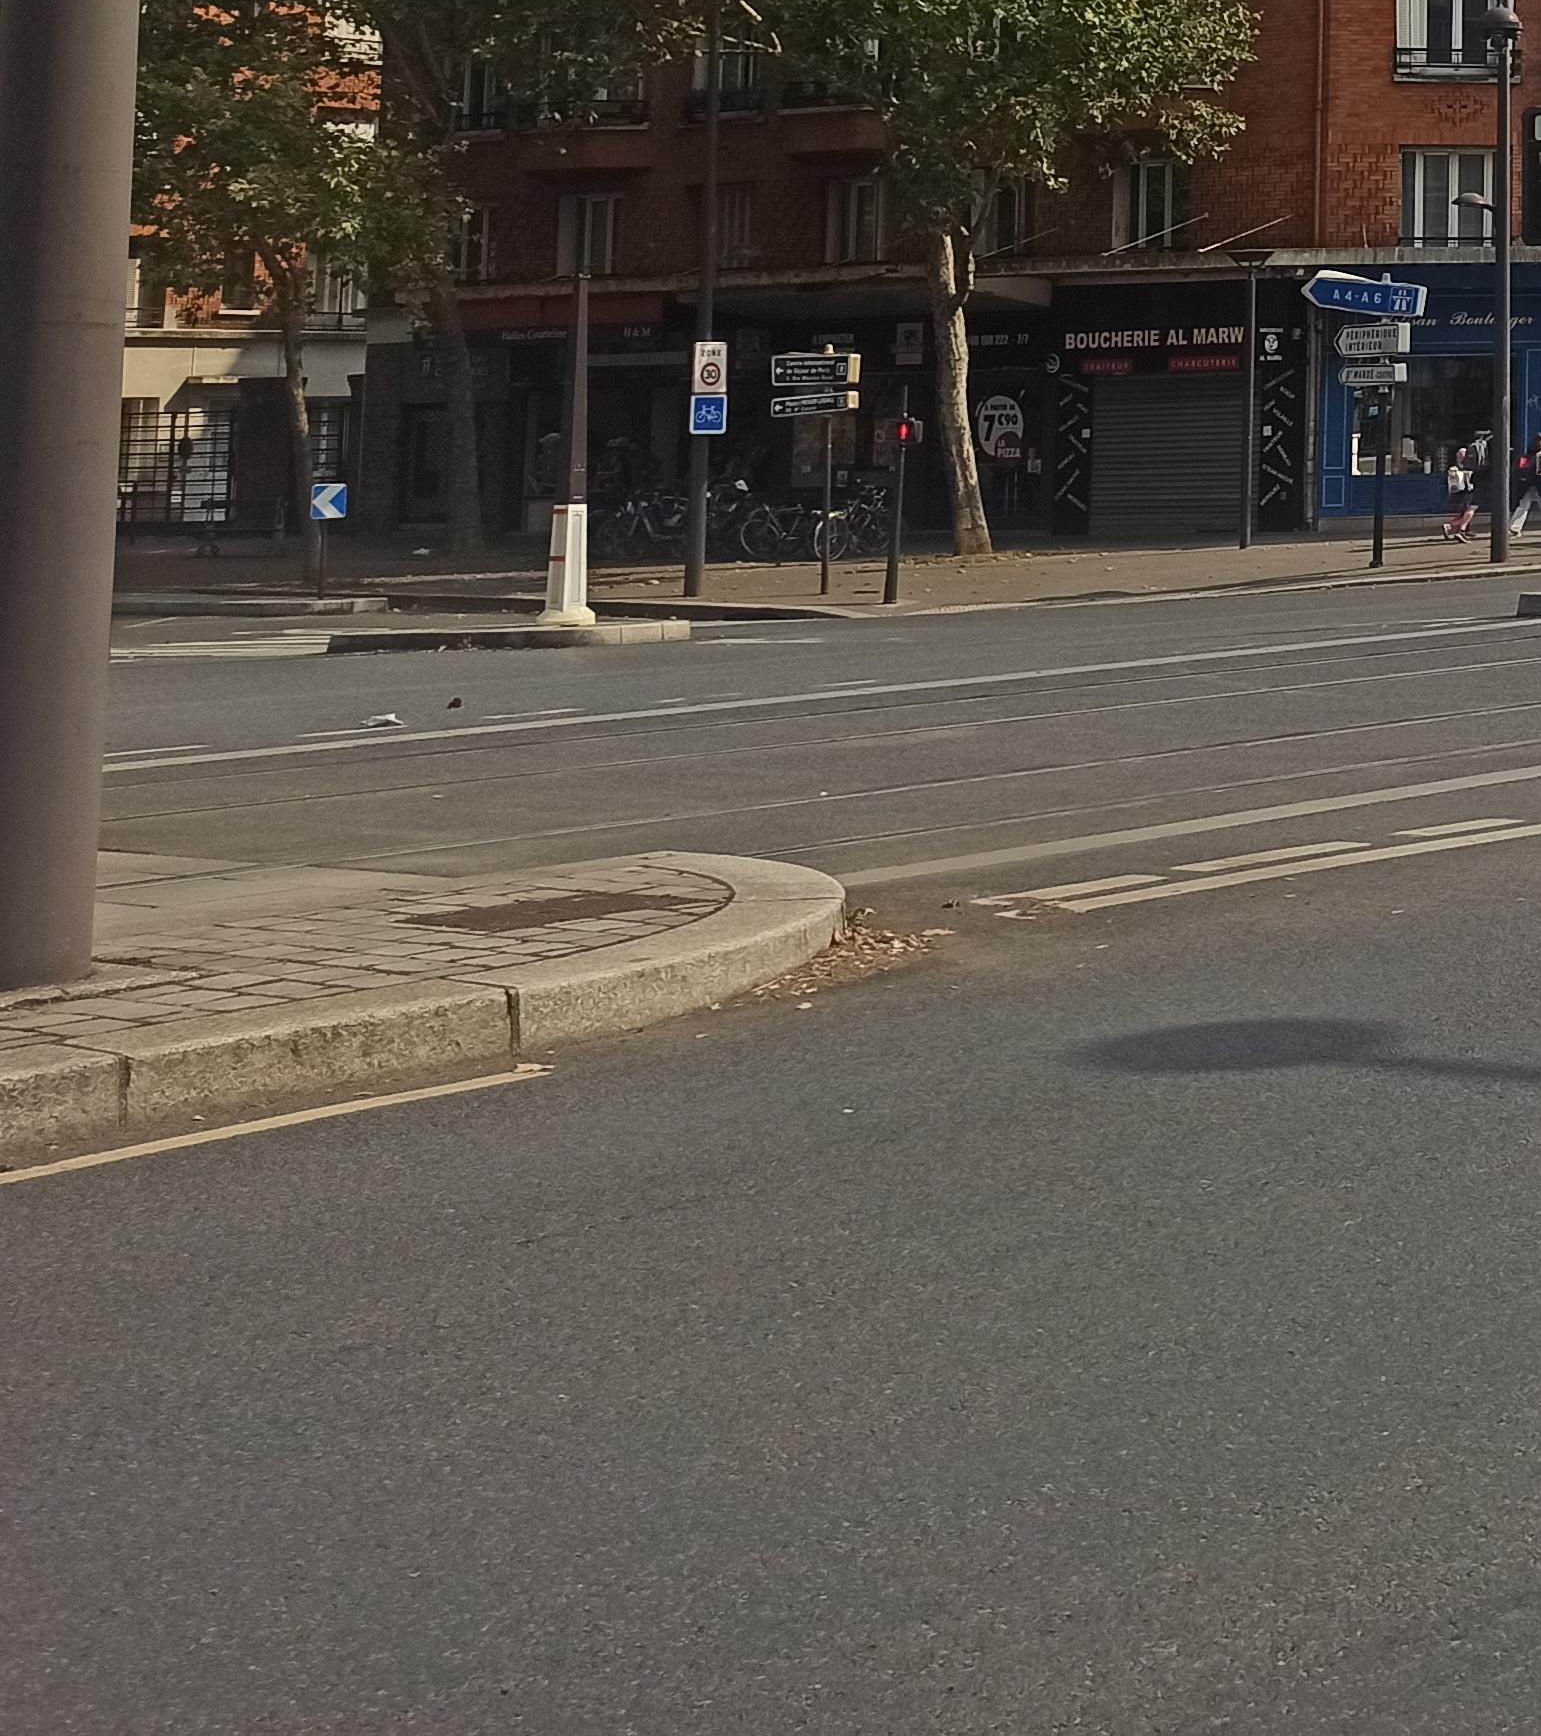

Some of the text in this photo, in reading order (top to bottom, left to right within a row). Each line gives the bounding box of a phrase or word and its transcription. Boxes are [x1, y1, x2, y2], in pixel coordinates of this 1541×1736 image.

[1065, 330, 1160, 350] BOUCHERIE
[1166, 329, 1188, 346] AL
[1345, 327, 1398, 341] PÉRIPHÉRIQUE
[1344, 340, 1383, 352] INTÉRIEUR
[701, 349, 721, 357] ZONE
[1171, 359, 1237, 368] CHARCUTERIE
[705, 369, 717, 379] 30
[983, 414, 996, 442] 7
[997, 439, 1006, 447] LA
[997, 447, 1021, 458] PIZZA
